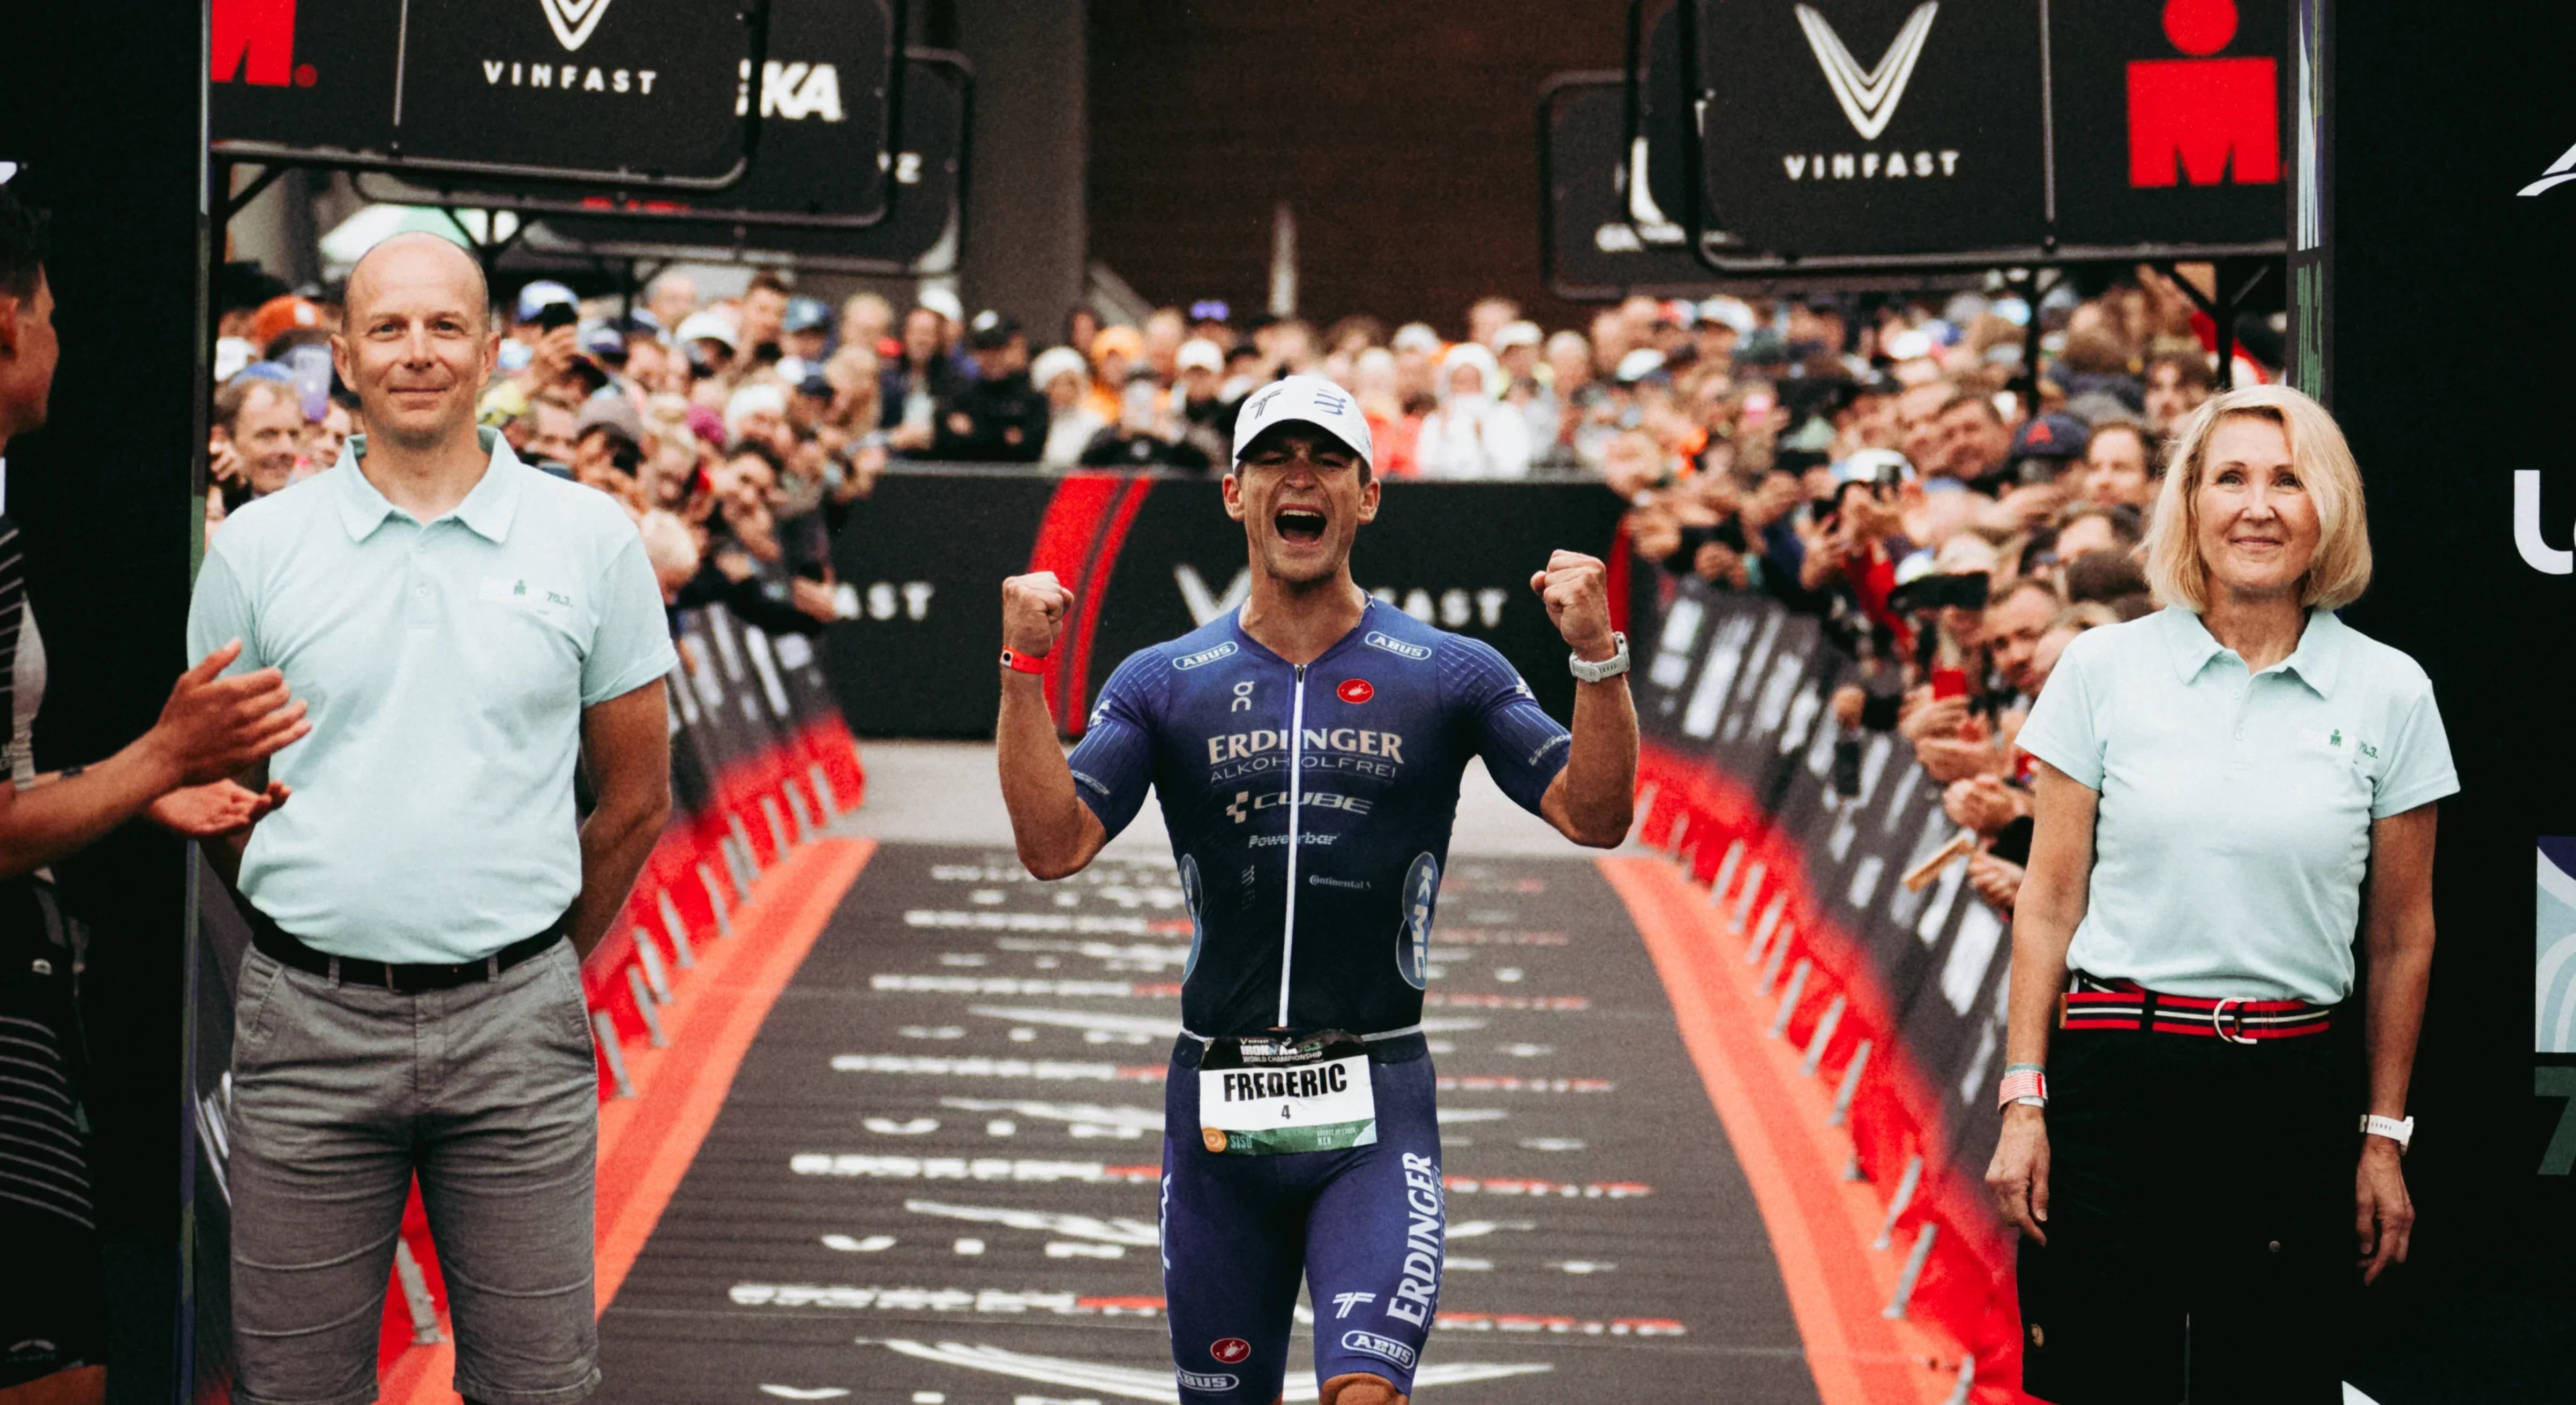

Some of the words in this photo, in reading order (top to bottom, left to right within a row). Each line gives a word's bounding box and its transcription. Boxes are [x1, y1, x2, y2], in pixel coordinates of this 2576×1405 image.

[482, 60, 657, 94] VINFAST
[1783, 150, 1960, 181] VINFAST
[1182, 643, 1232, 667] ABUS
[1374, 635, 1426, 658] ABUS
[1207, 727, 1404, 765] ERDINGER
[1210, 756, 1396, 784] ALKOHOLFREI
[1254, 792, 1374, 815] CUBE
[1309, 875, 1364, 889] Continental
[1267, 1050, 1323, 1063] CHAMPIONSHIP
[1223, 1063, 1347, 1102] FREDERIC
[1281, 1105, 1291, 1120] 4
[1386, 1152, 1440, 1329] ERDINGER
[1353, 1335, 1412, 1364] ABUS
